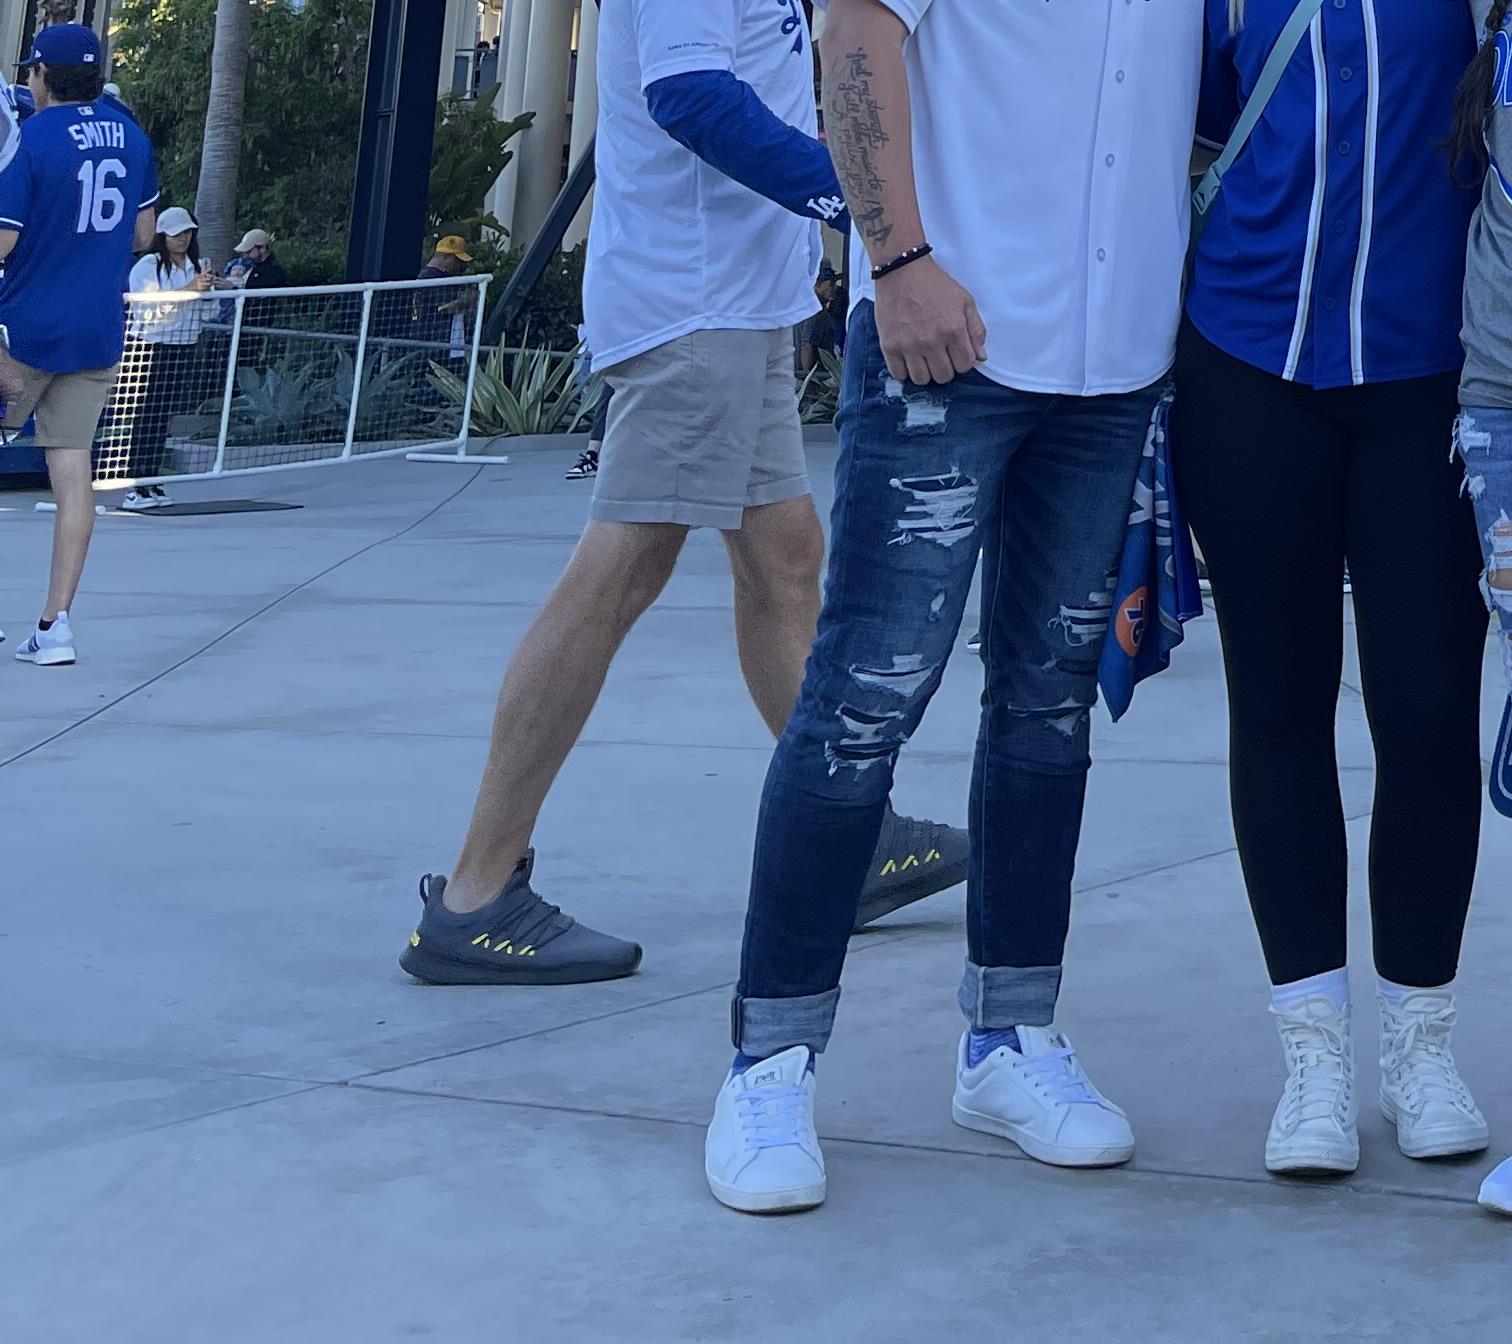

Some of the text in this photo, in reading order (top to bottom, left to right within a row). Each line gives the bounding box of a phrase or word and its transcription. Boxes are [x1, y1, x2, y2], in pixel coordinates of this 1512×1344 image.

[68, 120, 125, 151] SMITH
[76, 158, 127, 234] 16
[806, 195, 846, 220] LA
